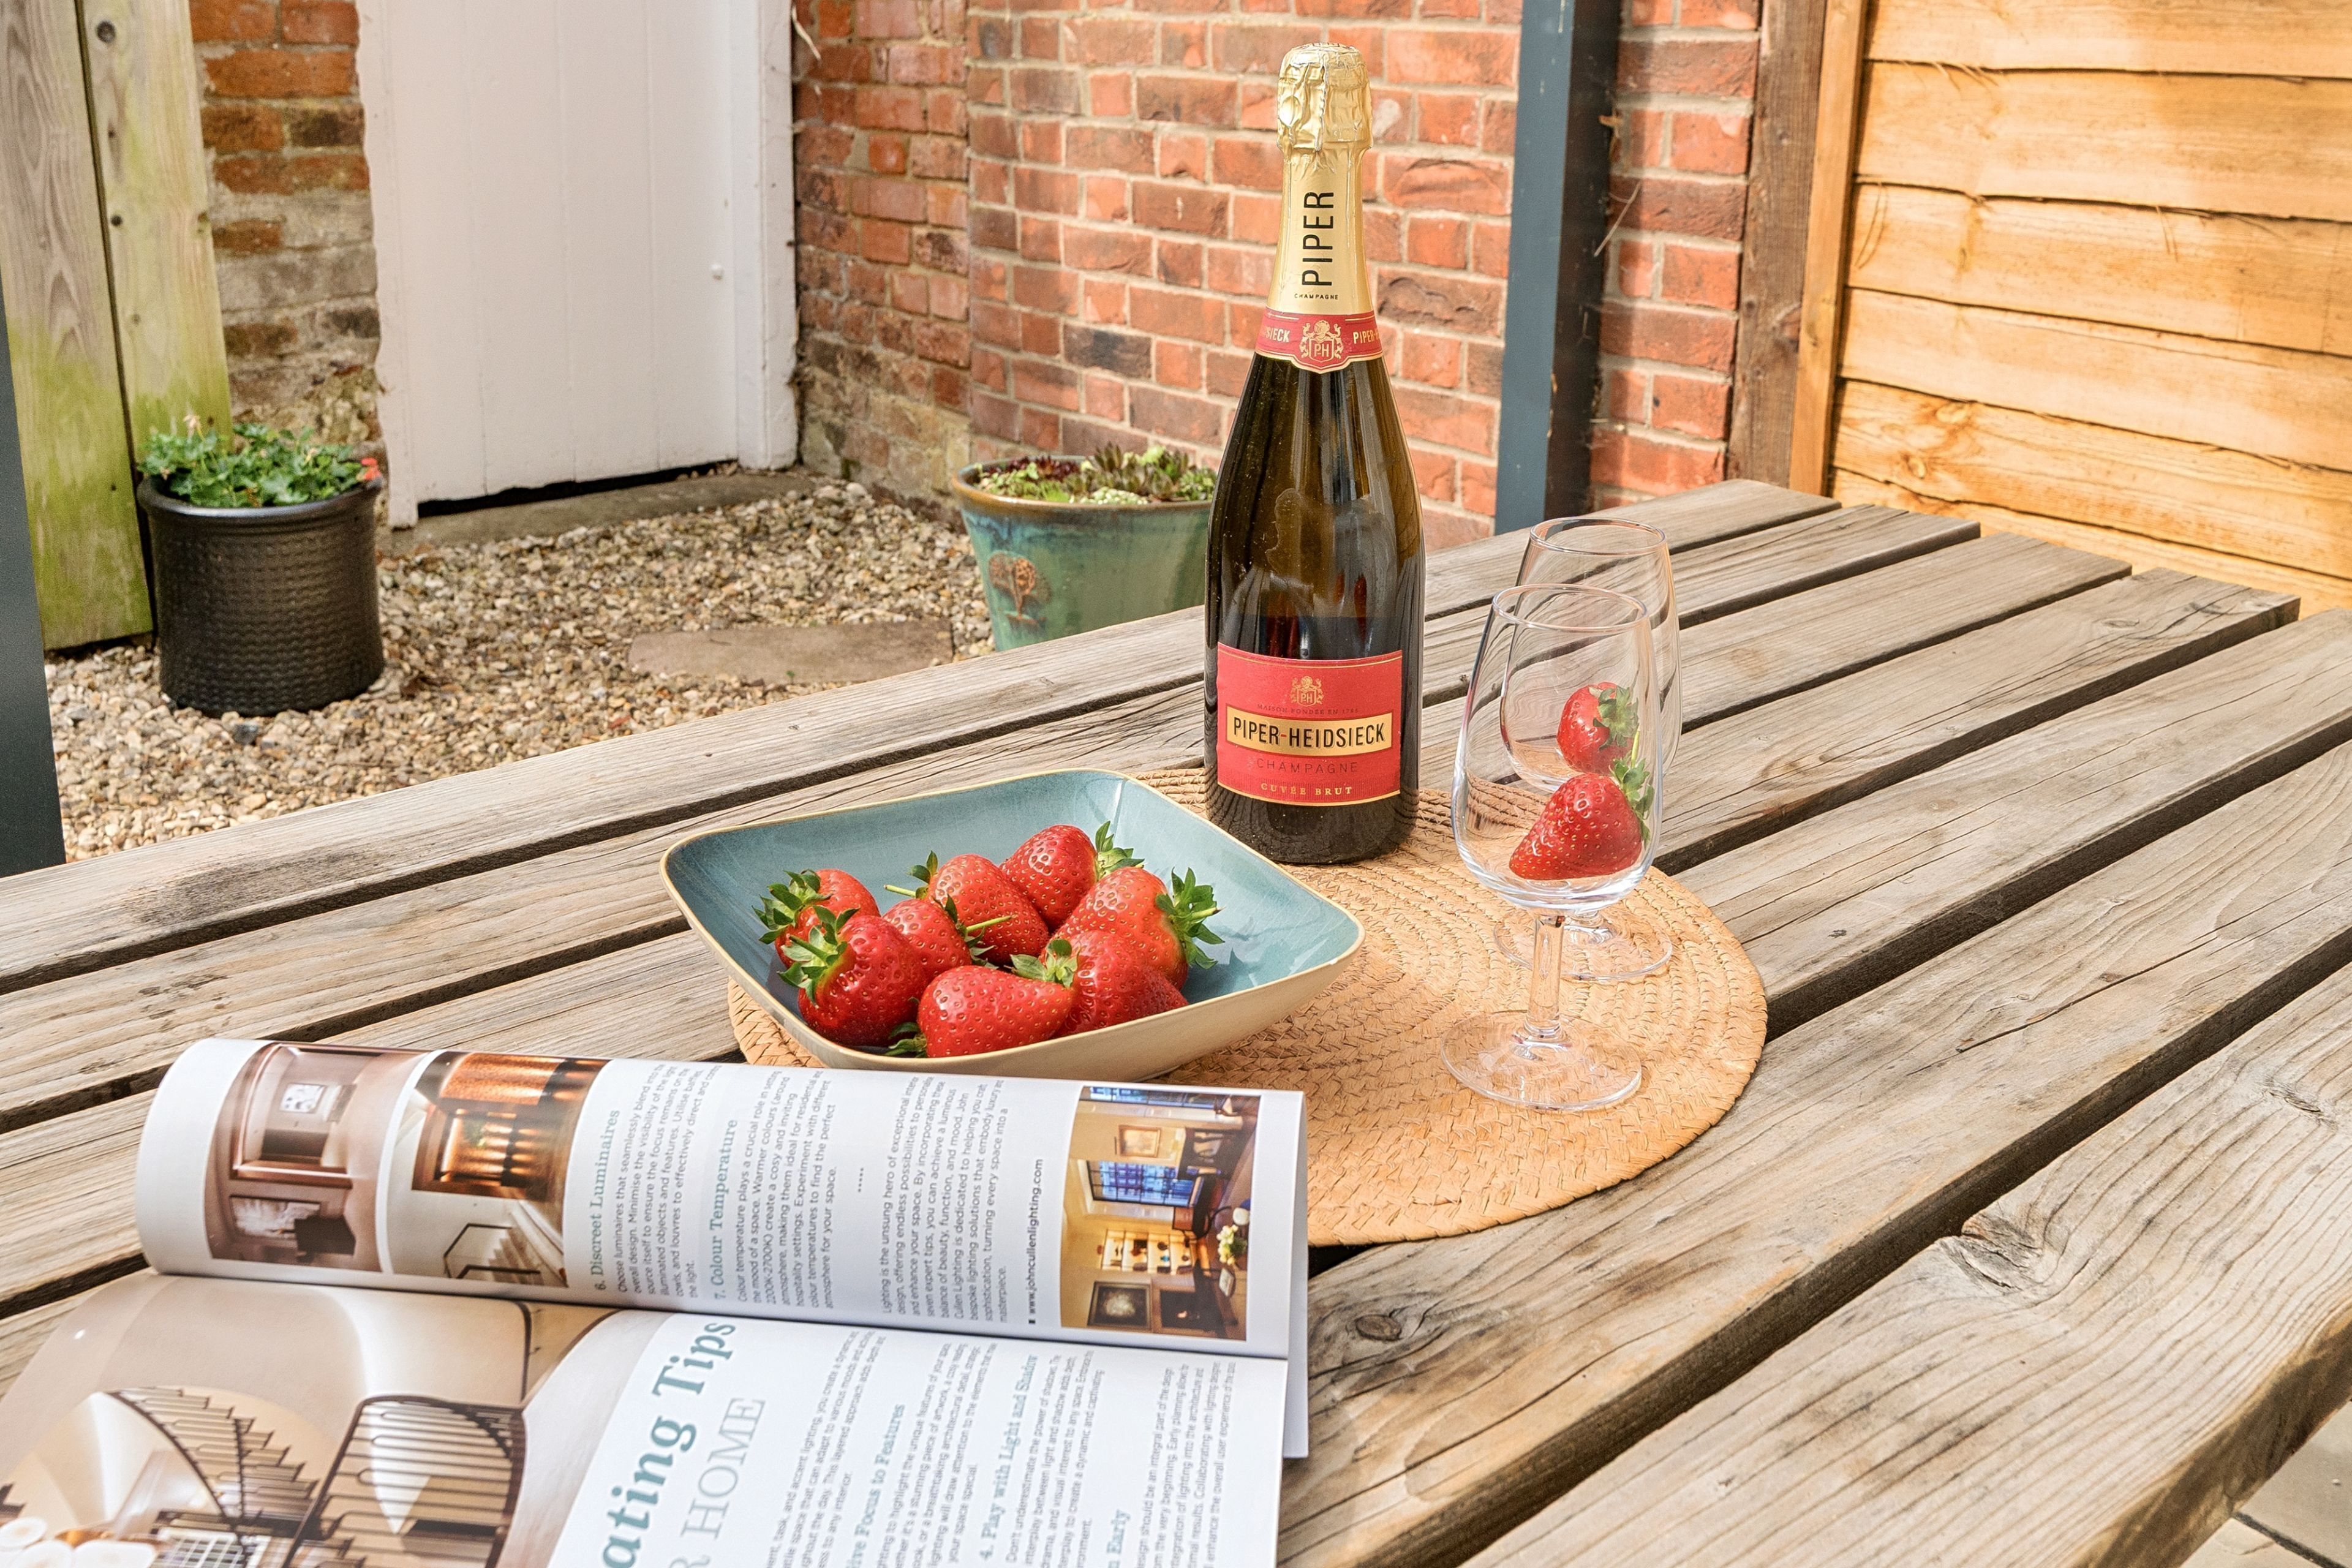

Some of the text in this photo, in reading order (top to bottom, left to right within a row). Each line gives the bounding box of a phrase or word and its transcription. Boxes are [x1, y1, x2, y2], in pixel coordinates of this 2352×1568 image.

[1302, 192, 1334, 285] PIPER
[1264, 326, 1291, 343] SIECK
[1257, 704, 1287, 713] MAISON
[1234, 717, 1385, 748] PIPER-HEIDSIECK
[1257, 758, 1358, 774] CHAMPAGNE
[672, 1093, 690, 1123] Utilise
[753, 1100, 766, 1119] role
[780, 1093, 798, 1127] inviting
[891, 1097, 910, 1153] exceptional
[937, 1088, 957, 1125] luminous
[996, 1115, 1007, 1135] into
[638, 1104, 659, 1148] visibility
[744, 1121, 759, 1158] crucial
[761, 1107, 778, 1145] colours
[774, 1129, 786, 1151] and
[790, 1121, 802, 1137] for
[793, 1140, 813, 1207] Experiment
[806, 1114, 818, 1137] with
[812, 1080, 831, 1113] different
[918, 1099, 940, 1167] incorporating
[633, 1150, 646, 1170] the
[752, 1148, 767, 1194] Warmer
[769, 1153, 783, 1181] cosy
[785, 1139, 797, 1167] ideal
[887, 1155, 897, 1169] of
[930, 1136, 944, 1180] achieve
[990, 1137, 1003, 1170] space
[613, 1085, 651, 1259] luminaires that seamlessly blend
[641, 1088, 678, 1265] itself to ensure the focus remains
[660, 1177, 670, 1200] and
[669, 1098, 703, 1270] and louvres to effectively direct
[737, 1170, 750, 1202] plays
[780, 1170, 793, 1201] them
[883, 1171, 895, 1199] hero
[913, 1169, 926, 1186] By
[937, 1272, 948, 1284] of
[946, 1148, 957, 1171] and
[956, 1093, 969, 1112] John
[987, 1172, 999, 1207] every
[589, 1110, 620, 1291] 6. Discreet Luminaires
[627, 1172, 642, 1224] Minimise
[709, 1120, 737, 1300] 7. Colour Temperature
[807, 1104, 836, 1280] temperatures to find the perfect
[893, 1112, 921, 1284] offering endless possibilities to
[927, 1182, 937, 1204] can
[952, 1117, 979, 1292] Lighting is dedicated to helping
[967, 1112, 994, 1283] lighting solutions that embody
[656, 1202, 668, 1245] objects
[765, 1194, 775, 1231] create
[777, 1204, 791, 1246] making
[823, 1207, 833, 1234] your
[881, 1201, 894, 1245] unsung
[925, 1207, 936, 1229] you
[982, 1209, 996, 1253] turning
[735, 1204, 746, 1272] temperature
[748, 1246, 759, 1259] of
[820, 1236, 831, 1253] for
[910, 1229, 920, 1256] your
[1026, 1159, 1043, 1314] www.johncullenlighting.com
[748, 1260, 760, 1289] mood
[879, 1247, 889, 1265] the
[881, 1268, 890, 1277] is
[908, 1257, 919, 1300] enhance
[924, 1259, 933, 1292] expert
[652, 1323, 736, 1396] Tips
[1011, 1394, 1028, 1419] and
[874, 1404, 905, 1466] Features
[998, 1421, 1021, 1461] Light
[680, 1398, 766, 1540] HOME
[870, 1468, 886, 1485] to
[993, 1464, 1011, 1499] with
[854, 1488, 881, 1537] Focus
[981, 1502, 1005, 1540] Play
[1106, 1509, 1129, 1555] Early
[979, 1545, 994, 1561] 4.
